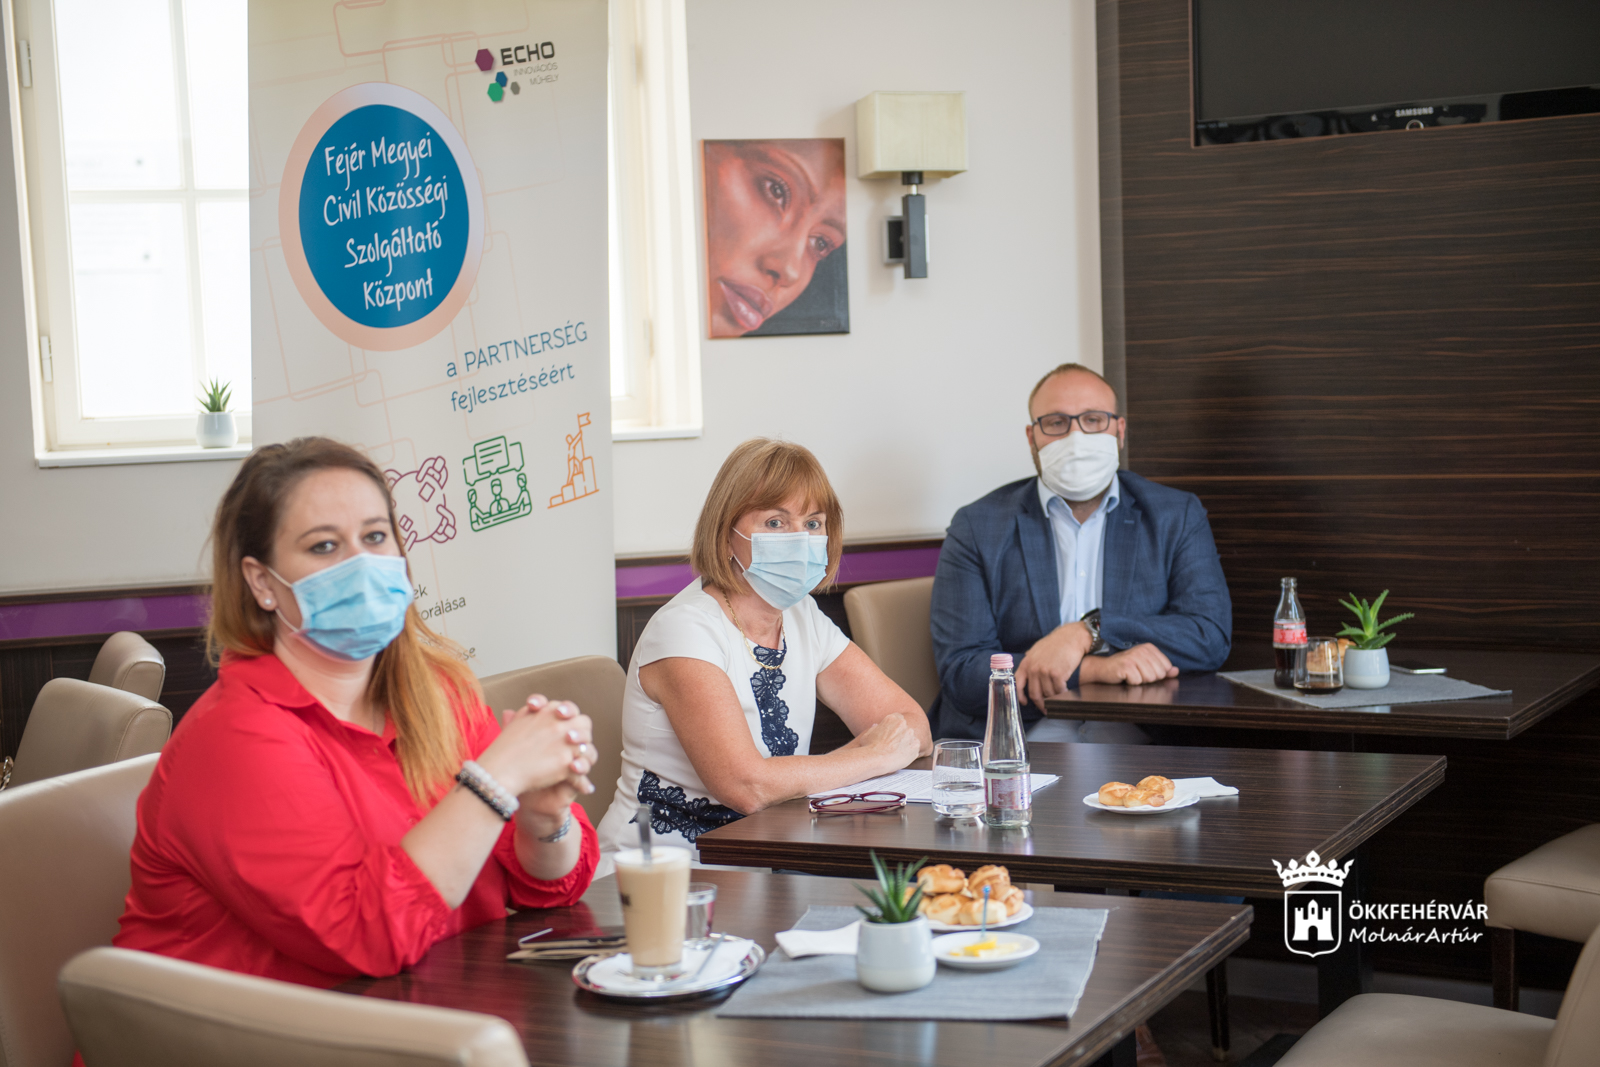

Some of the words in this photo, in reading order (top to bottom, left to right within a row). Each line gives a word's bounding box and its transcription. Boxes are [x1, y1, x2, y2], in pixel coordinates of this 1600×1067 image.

[500, 41, 555, 66] ECHO
[1395, 106, 1434, 118] SAMSUNG
[325, 142, 366, 191] Fejér
[371, 131, 432, 180] Megyei
[323, 189, 361, 226] Civil
[366, 175, 448, 220] Közösségi
[344, 220, 442, 277] Szolgáltató
[363, 268, 433, 311] Központ
[446, 362, 457, 377] a
[464, 320, 588, 372] PARTNERSÉG
[451, 363, 575, 413] fejlesztéséért
[413, 584, 428, 600] ek
[418, 596, 466, 620] orálása
